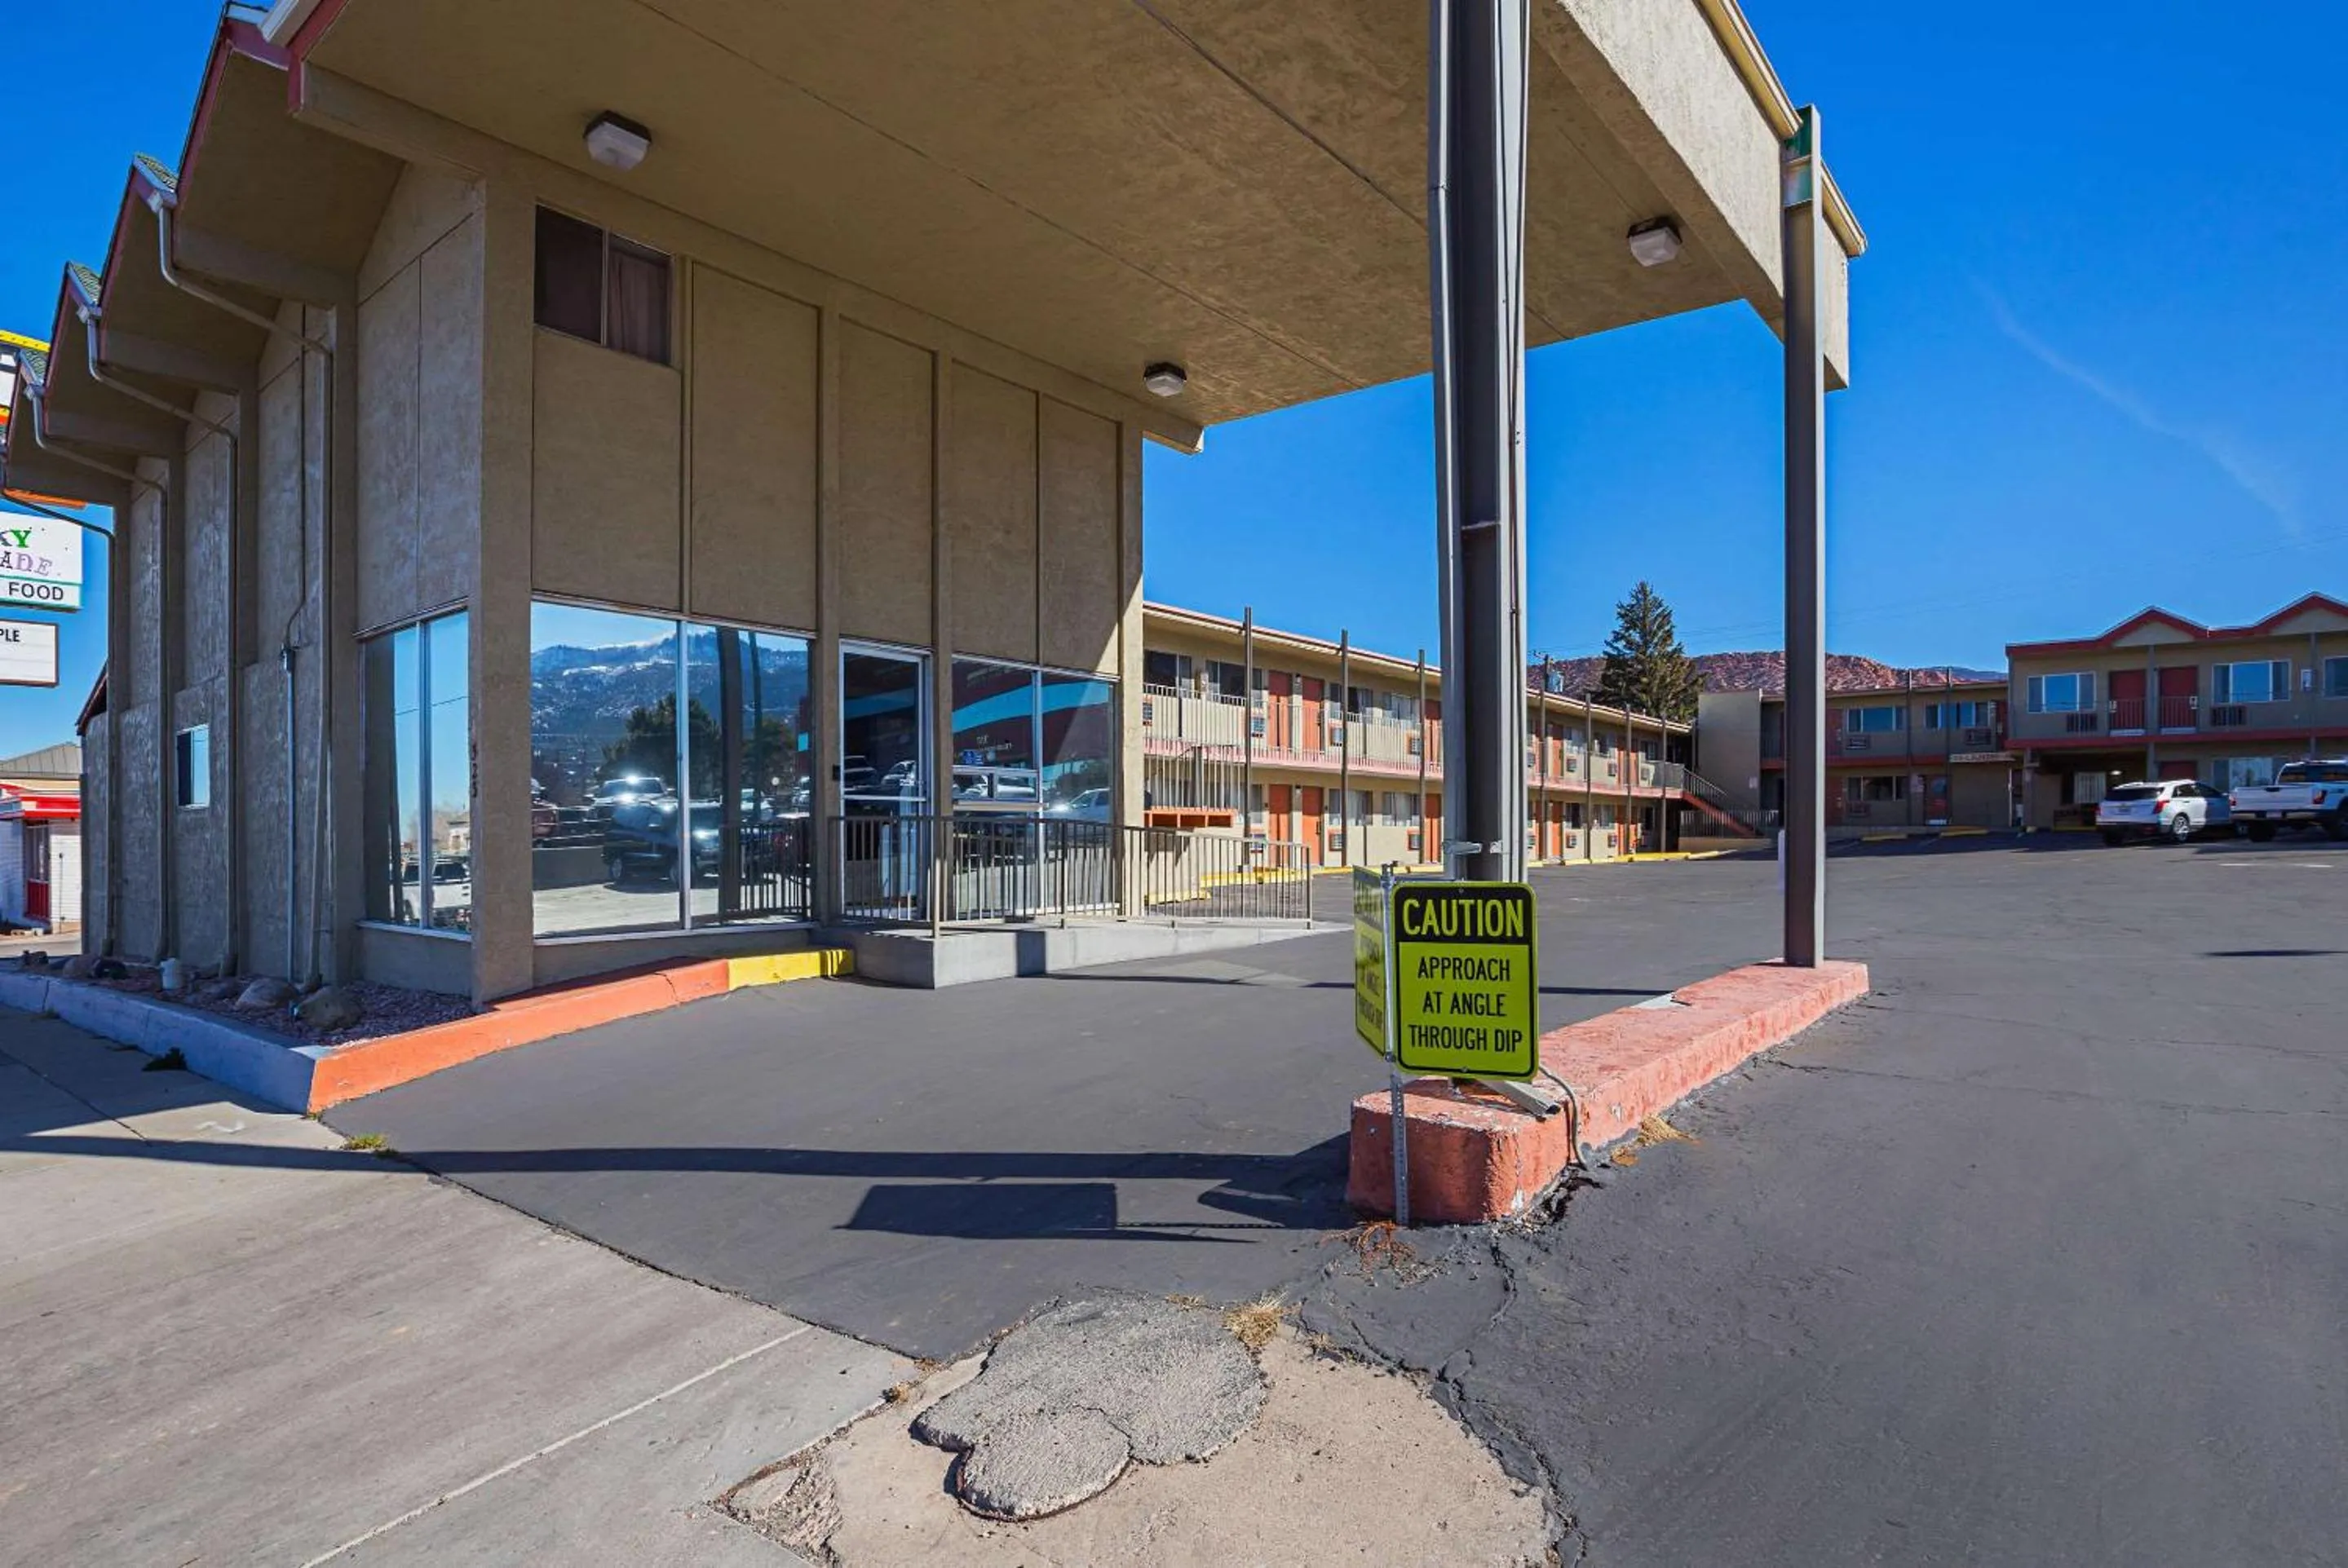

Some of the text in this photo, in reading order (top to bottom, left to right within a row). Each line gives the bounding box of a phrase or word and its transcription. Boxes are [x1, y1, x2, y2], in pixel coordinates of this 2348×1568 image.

[9, 581, 64, 600] FOOD
[1402, 899, 1523, 937] CAUTION
[1417, 956, 1510, 982] APPROACH
[1422, 992, 1506, 1017] AT ANGLE
[1408, 1025, 1522, 1052] THROUGH DIP
